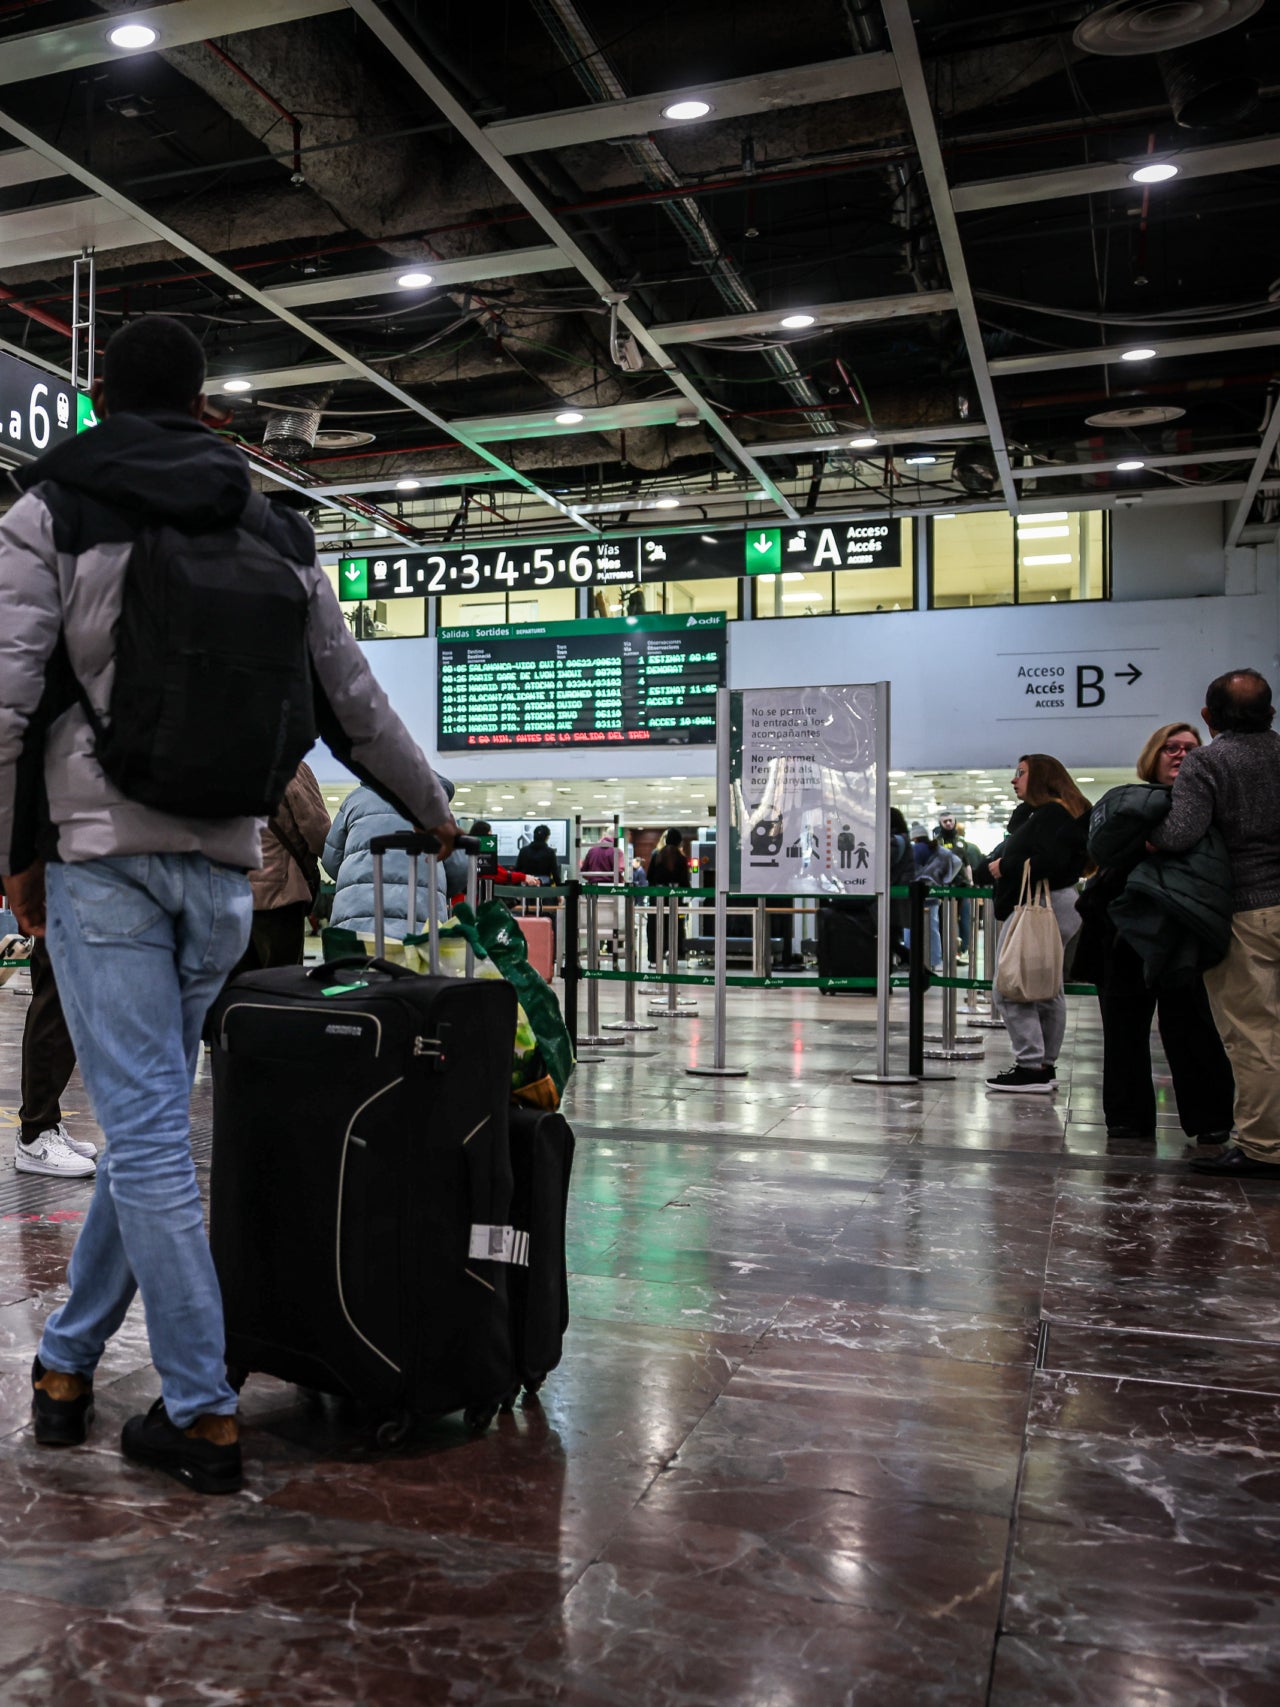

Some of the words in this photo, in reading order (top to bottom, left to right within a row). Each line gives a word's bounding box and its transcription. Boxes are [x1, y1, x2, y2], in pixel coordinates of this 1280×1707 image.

[9, 409, 21, 440] a
[29, 383, 50, 449] 6
[847, 526, 889, 539] Acceso
[597, 544, 620, 556] Vías
[813, 528, 842, 567] A
[847, 539, 882, 553] Accés
[847, 555, 873, 564] ACCESS
[698, 616, 720, 625] adif
[442, 629, 470, 639] Salidas
[476, 627, 509, 637] Sortides
[516, 627, 546, 635] DEPARTURES
[648, 654, 686, 664] ESTIMAT
[469, 673, 493, 682] PARIS
[497, 672, 516, 681] GARE
[520, 672, 531, 680] DE
[534, 671, 555, 679] LYON
[1017, 666, 1065, 678] Acceso
[469, 683, 498, 692] MADRID
[501, 682, 520, 691] PTA.
[524, 681, 555, 690] ATOCHA
[648, 686, 686, 696] ESTIMAT
[1025, 680, 1065, 695] Accés
[1076, 665, 1106, 708] B
[469, 703, 498, 712] MADRID
[501, 703, 520, 711] PTA.
[524, 701, 555, 710] ATOCHA
[646, 697, 674, 706] ACCES
[1035, 699, 1065, 708] ACCESS
[469, 713, 498, 722] MADRID
[501, 713, 520, 721] PTA.
[524, 712, 555, 721] ATOCHA
[751, 708, 765, 717] No
[767, 709, 777, 717] se
[469, 723, 498, 732] MADRID
[501, 723, 520, 731] PTA.
[524, 721, 555, 731] ATOCHA
[556, 721, 573, 730] AVE
[648, 717, 676, 727] ACCES
[751, 719, 761, 728] la
[763, 718, 799, 728] entrada
[516, 733, 542, 742] ANTES
[544, 733, 556, 742] DE
[558, 733, 571, 742] LA
[574, 732, 605, 741] SALIDA
[607, 731, 624, 740] DEL
[751, 728, 821, 739] acompañantes
[751, 754, 764, 762] No
[844, 878, 867, 886] adif
